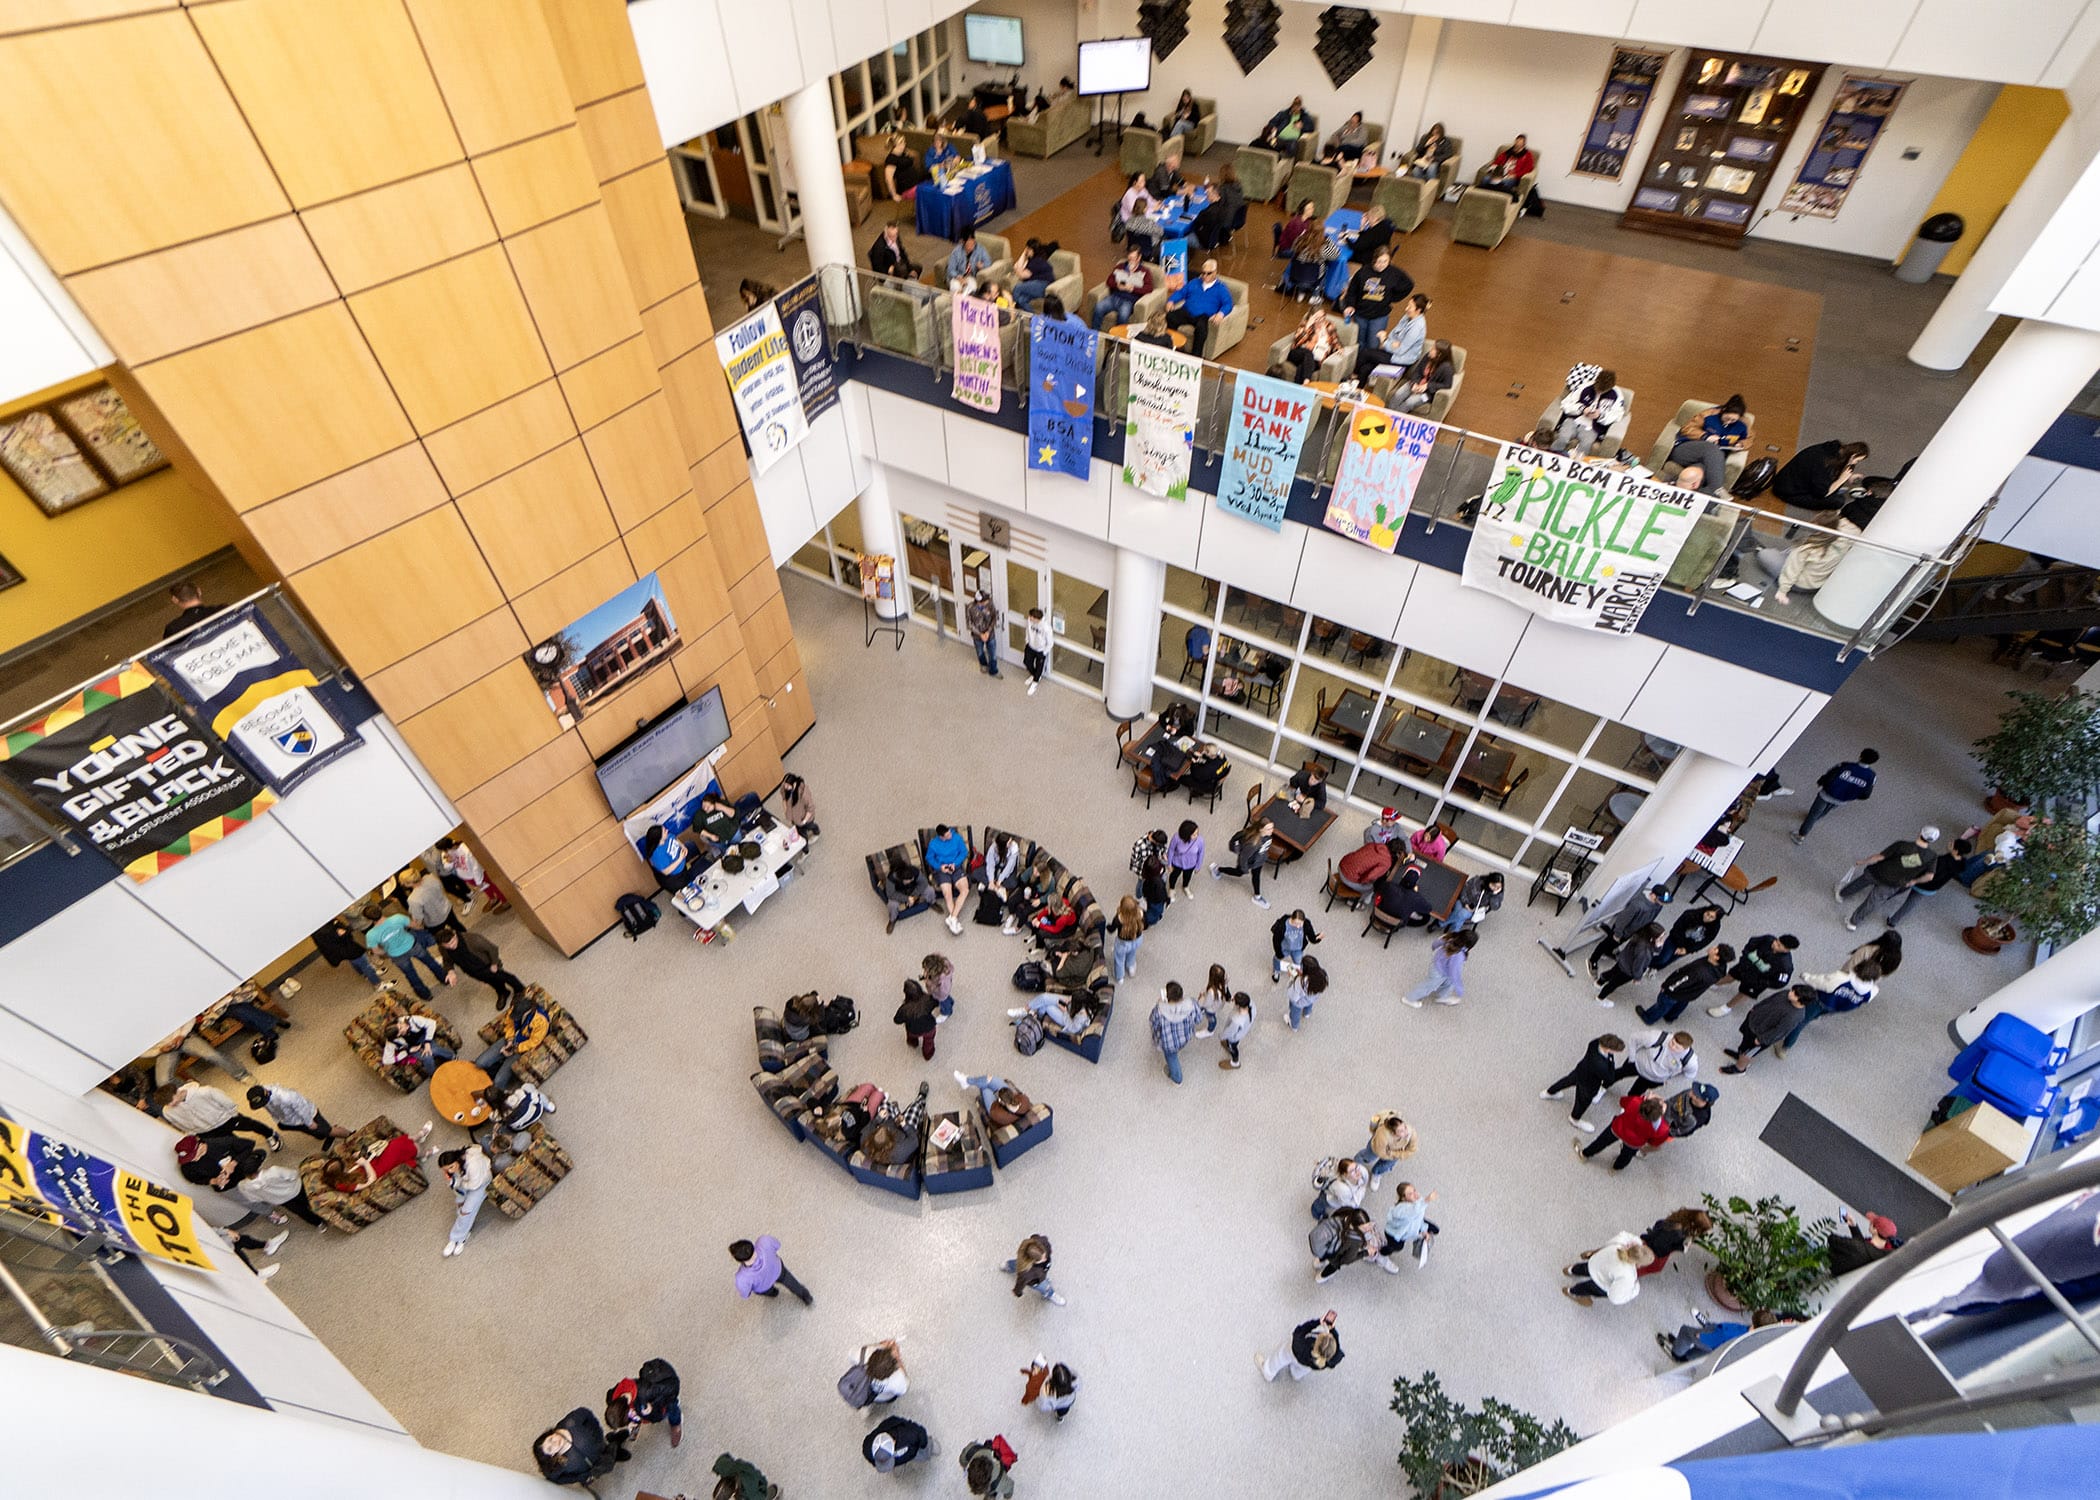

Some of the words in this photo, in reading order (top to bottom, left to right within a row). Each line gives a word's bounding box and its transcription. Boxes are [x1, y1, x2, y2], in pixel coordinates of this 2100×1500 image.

[960, 300, 995, 330] March
[729, 322, 767, 351] Follow
[728, 348, 764, 384] Student
[1133, 350, 1201, 382] TUESDAY
[1243, 386, 1308, 423] DUNK
[1046, 417, 1075, 442] BSA
[1242, 413, 1292, 442] TANK
[1390, 414, 1436, 444] THURS
[1232, 446, 1273, 476] MUD
[1342, 441, 1421, 498] BLOCK
[1505, 446, 1544, 468] FCA
[1566, 462, 1611, 488] BCM
[1513, 475, 1688, 562] PICKLE
[1522, 531, 1604, 586] BALL
[1497, 555, 1608, 610] TOURNEY
[1595, 571, 1653, 633] MARCH
[185, 639, 240, 674] BECOME
[241, 629, 254, 643] A
[240, 699, 293, 733] BECOME
[34, 713, 189, 793] YOUNG
[62, 738, 208, 822] GIFTED
[106, 829, 143, 852] BLACK
[139, 805, 183, 838] STUDENT
[184, 772, 246, 811] ASSOCIATION
[126, 1177, 144, 1223] THE
